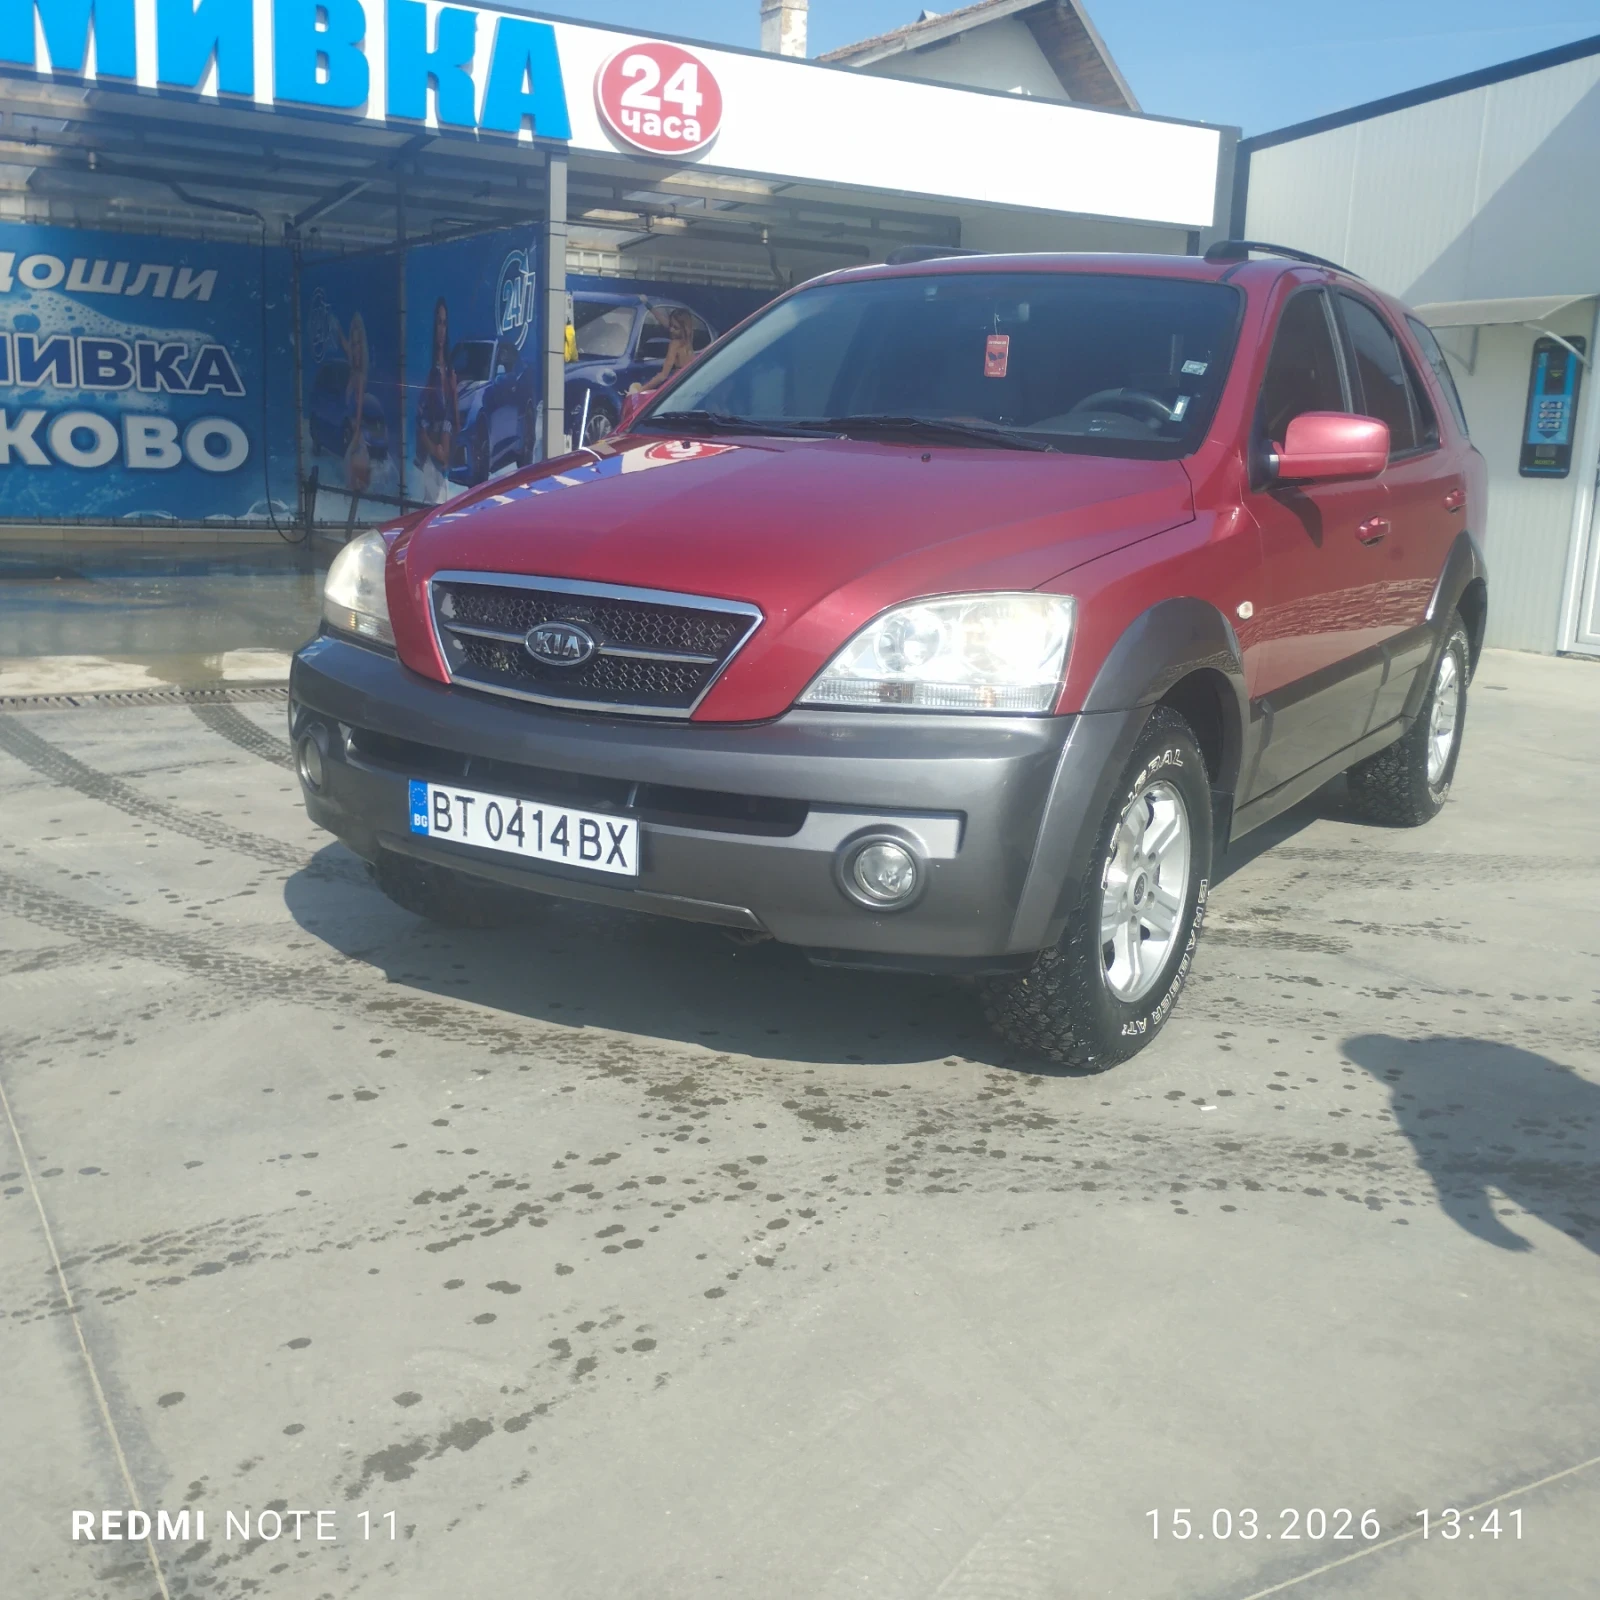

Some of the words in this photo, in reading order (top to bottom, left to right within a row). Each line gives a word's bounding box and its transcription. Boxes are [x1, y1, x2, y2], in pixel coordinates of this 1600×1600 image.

[621, 53, 703, 117] 24
[621, 108, 702, 143] часа
[502, 271, 536, 331] 24/7
[0, 331, 246, 397] ИВКА
[535, 631, 580, 658] KIA
[413, 813, 428, 828] BG
[433, 790, 476, 837] BT
[485, 800, 570, 857] 0414
[579, 817, 629, 868] BX
